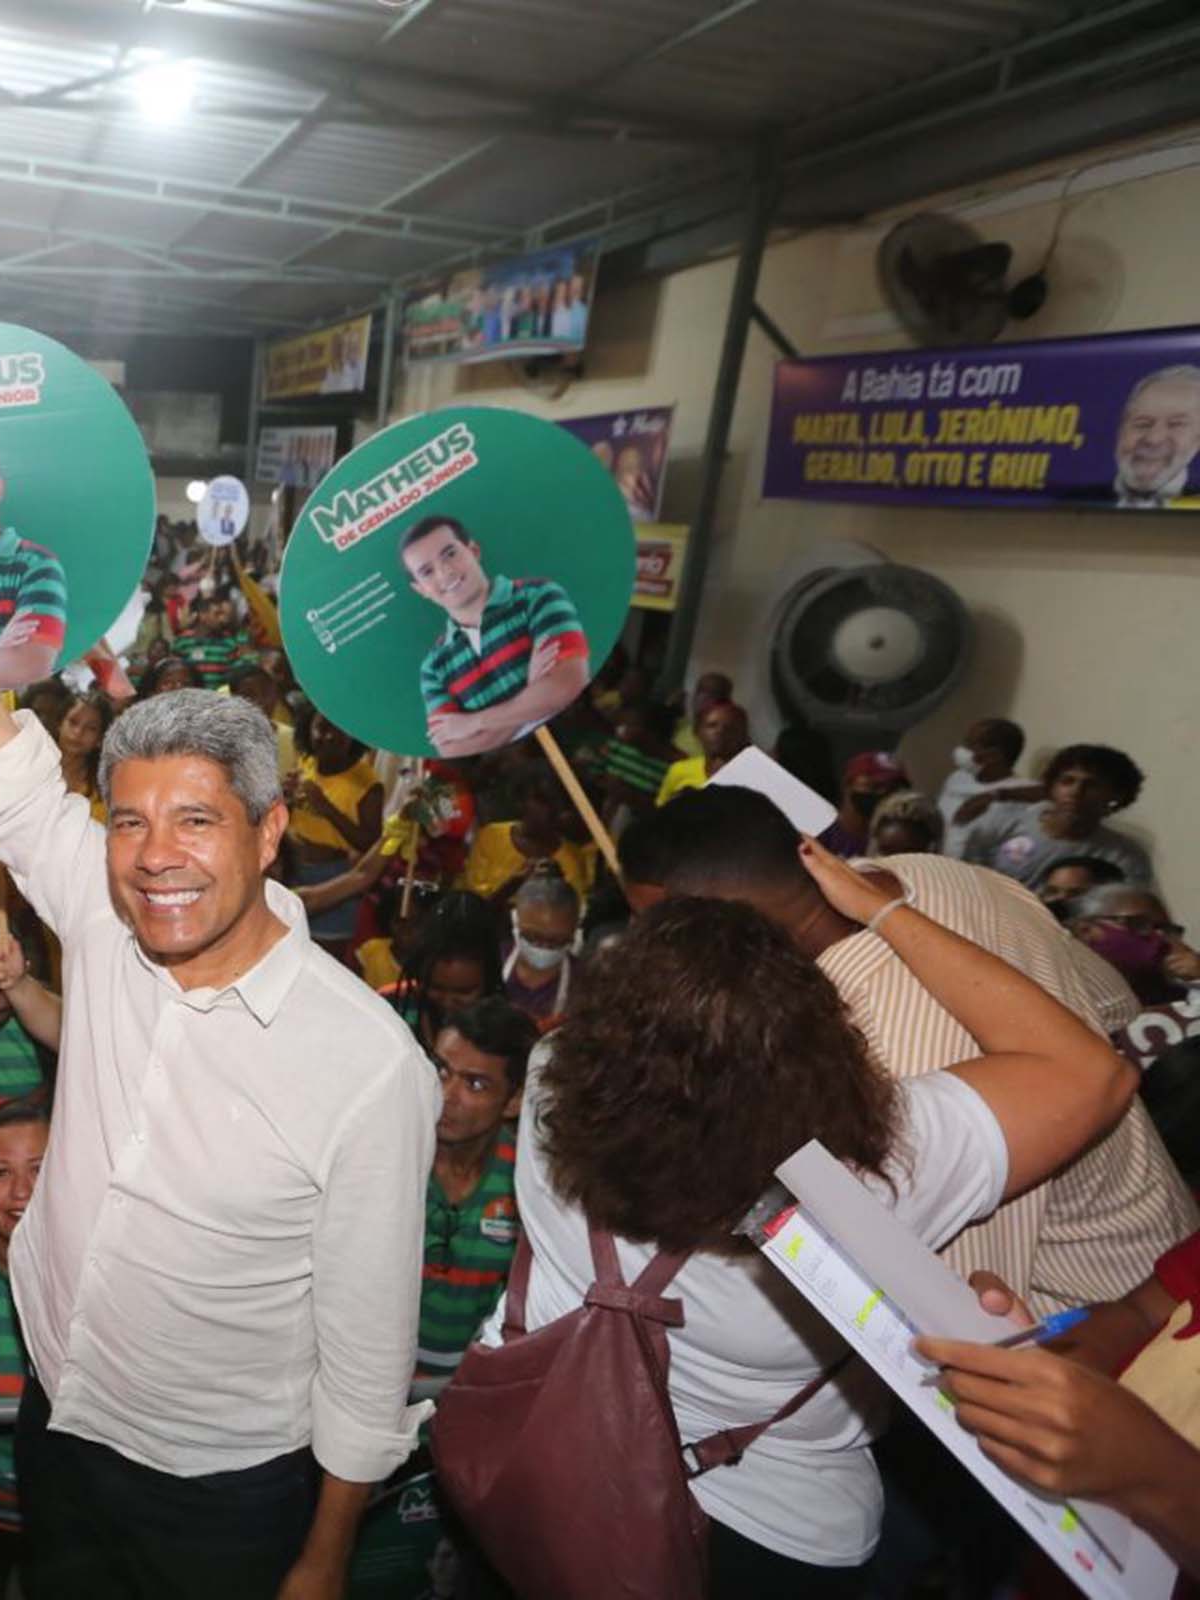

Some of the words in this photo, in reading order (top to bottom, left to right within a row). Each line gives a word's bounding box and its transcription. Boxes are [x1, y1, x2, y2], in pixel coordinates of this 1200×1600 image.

[841, 370, 856, 402] A
[860, 364, 924, 402] Bahia
[928, 359, 956, 399] tá
[959, 362, 1022, 398] com
[794, 412, 864, 447] MARTA,
[868, 410, 930, 447] LULA,
[932, 401, 1085, 450] JERÔNIMO,
[314, 427, 472, 538] MATHEUS
[804, 451, 901, 487] GERALDO,
[904, 452, 964, 486] OTTO
[966, 453, 987, 487] E
[988, 452, 1051, 489] RUI!
[338, 529, 359, 547] DE
[358, 488, 421, 533] GERALDO
